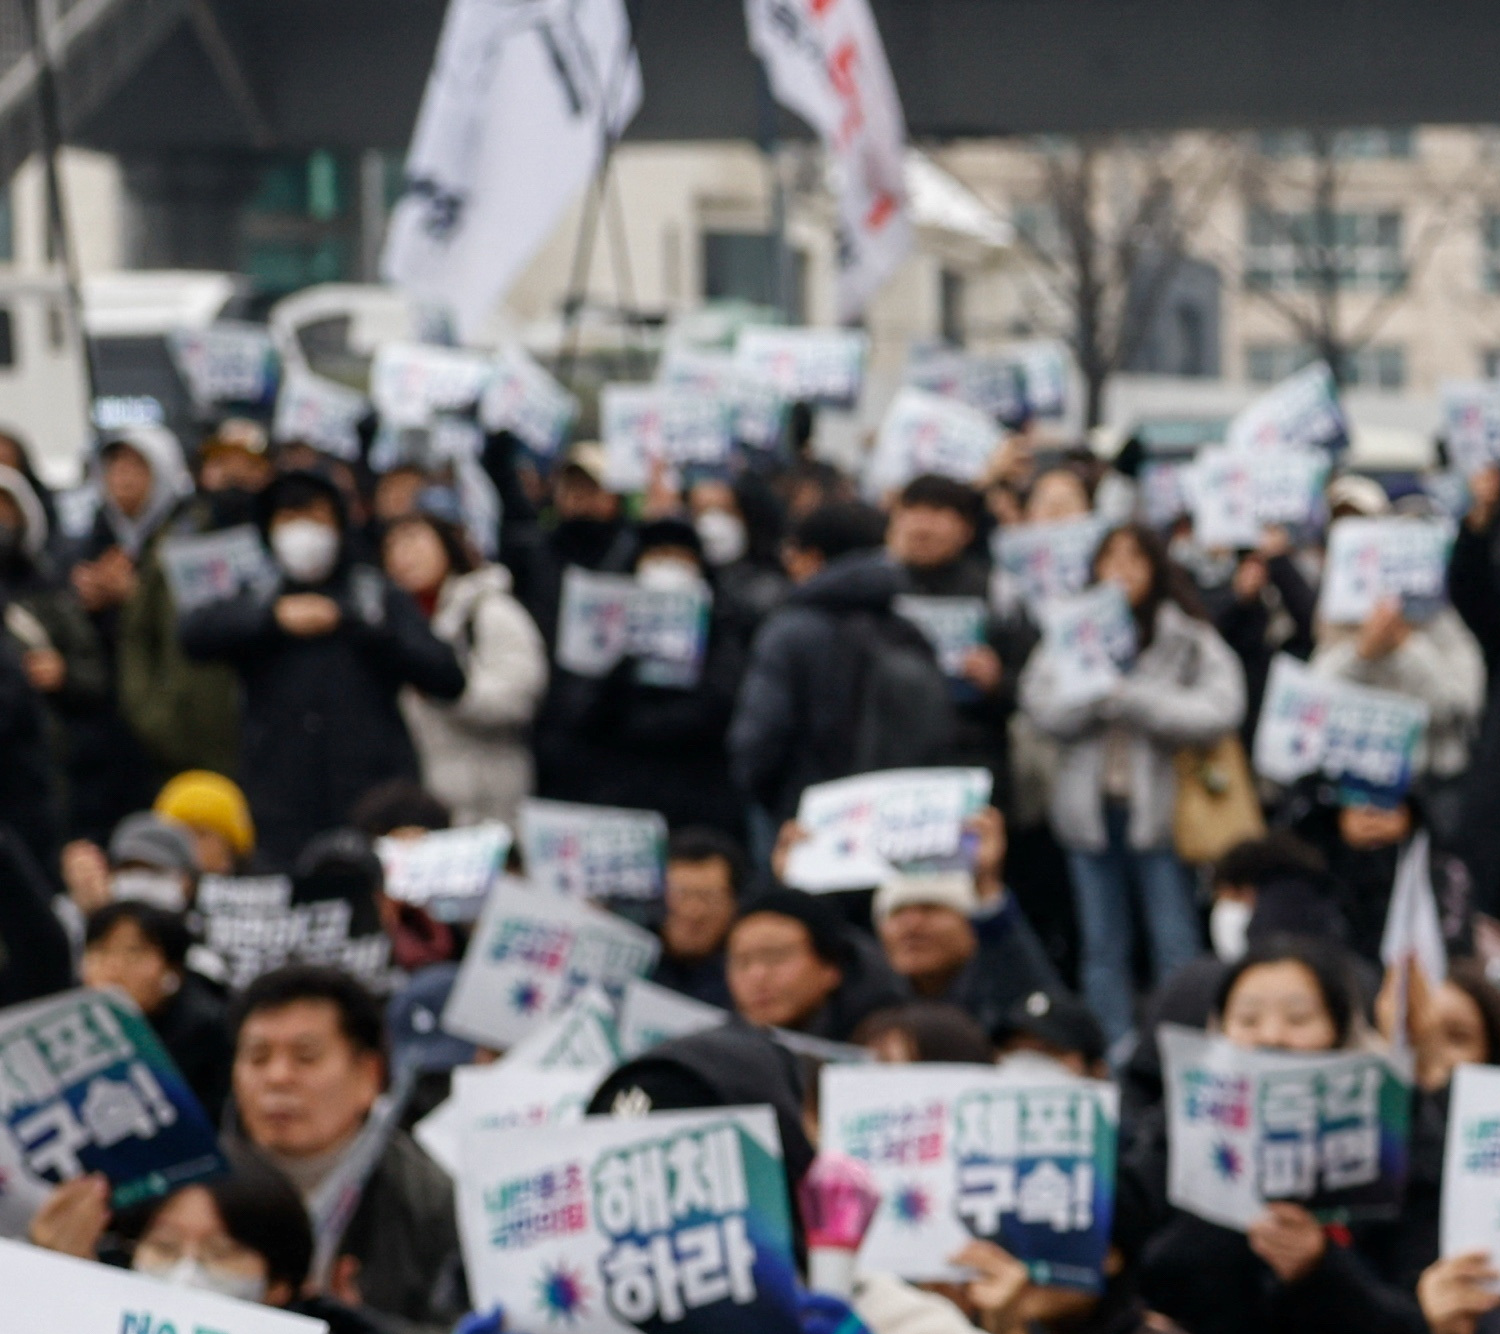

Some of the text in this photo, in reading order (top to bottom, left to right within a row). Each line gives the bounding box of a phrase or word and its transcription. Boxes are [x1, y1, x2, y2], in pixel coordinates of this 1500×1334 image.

[18, 1058, 177, 1178] 구속!
[957, 1160, 1095, 1243] 구속!
[602, 1218, 758, 1327] 하라
